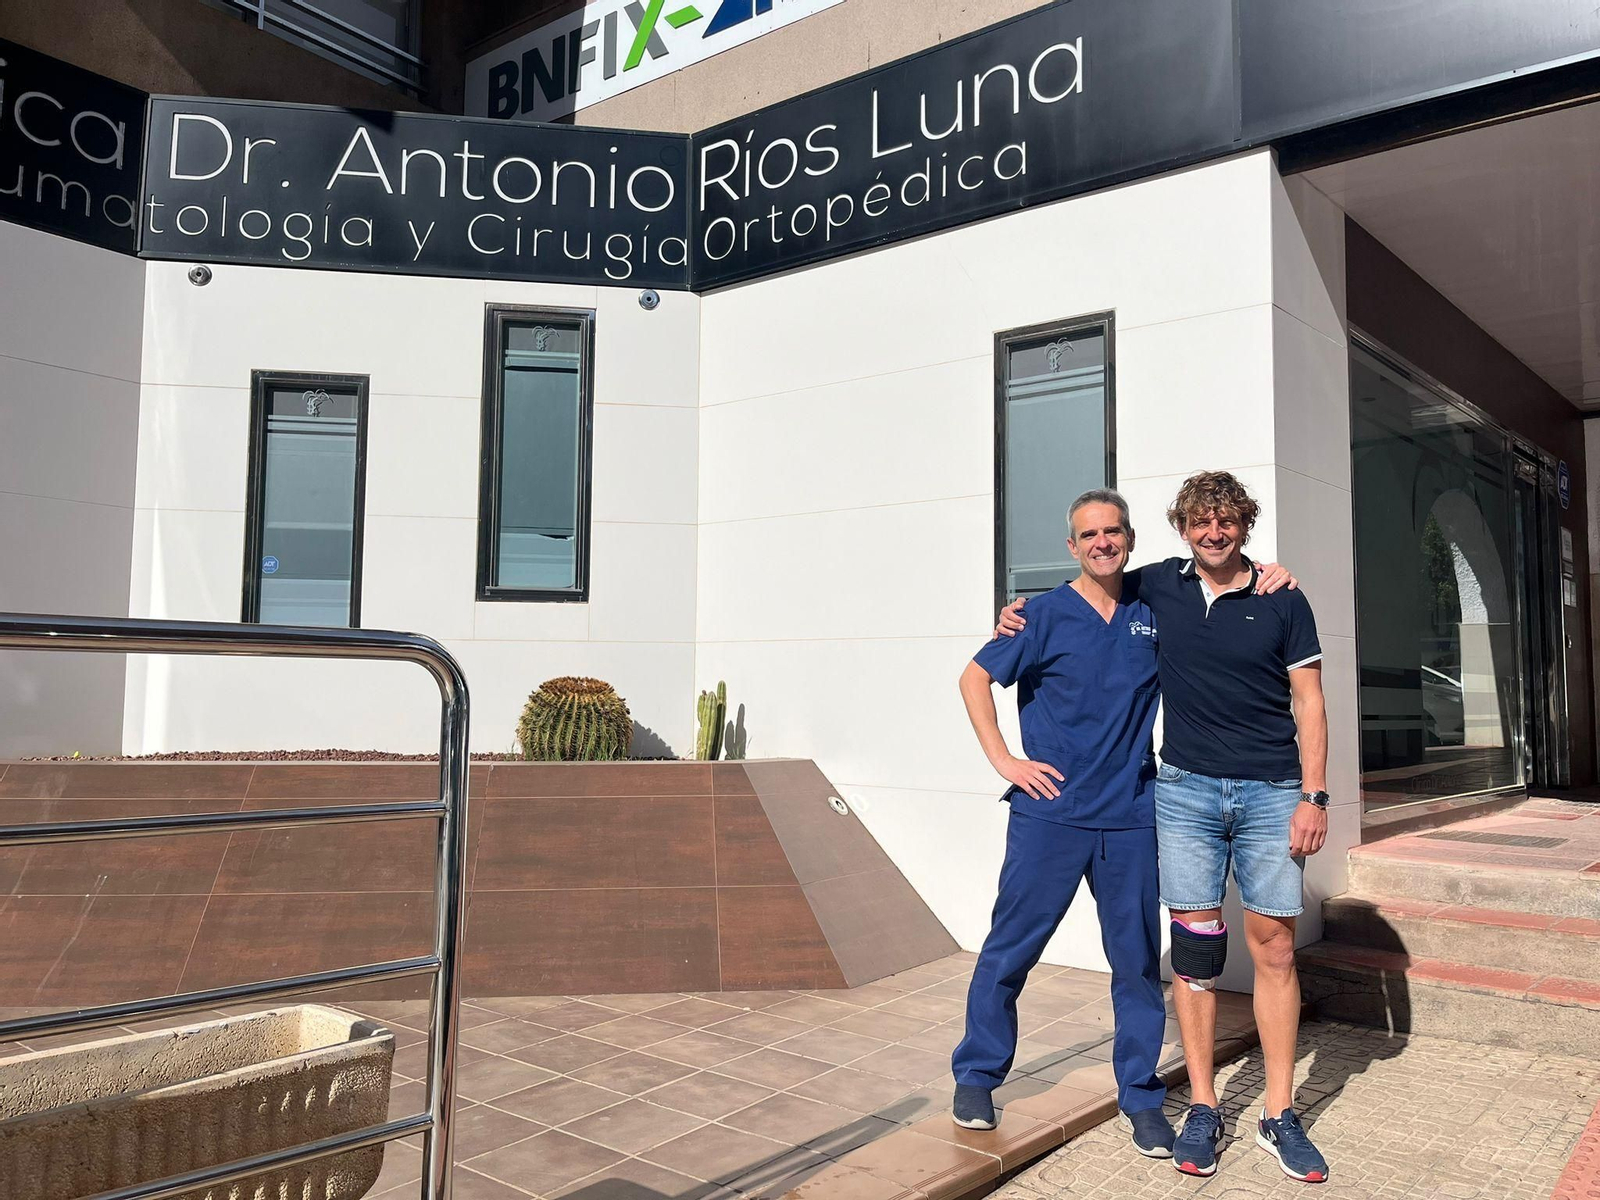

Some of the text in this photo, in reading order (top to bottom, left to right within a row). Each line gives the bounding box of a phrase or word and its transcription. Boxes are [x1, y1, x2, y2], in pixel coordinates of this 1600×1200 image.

[169, 113, 290, 188] Dr.
[326, 126, 675, 213] Antonio
[700, 124, 840, 212] Ríos
[872, 36, 1083, 159] Luna
[408, 220, 435, 262] y
[467, 213, 689, 280] Cirugía
[704, 141, 1027, 260] Ortopédica
